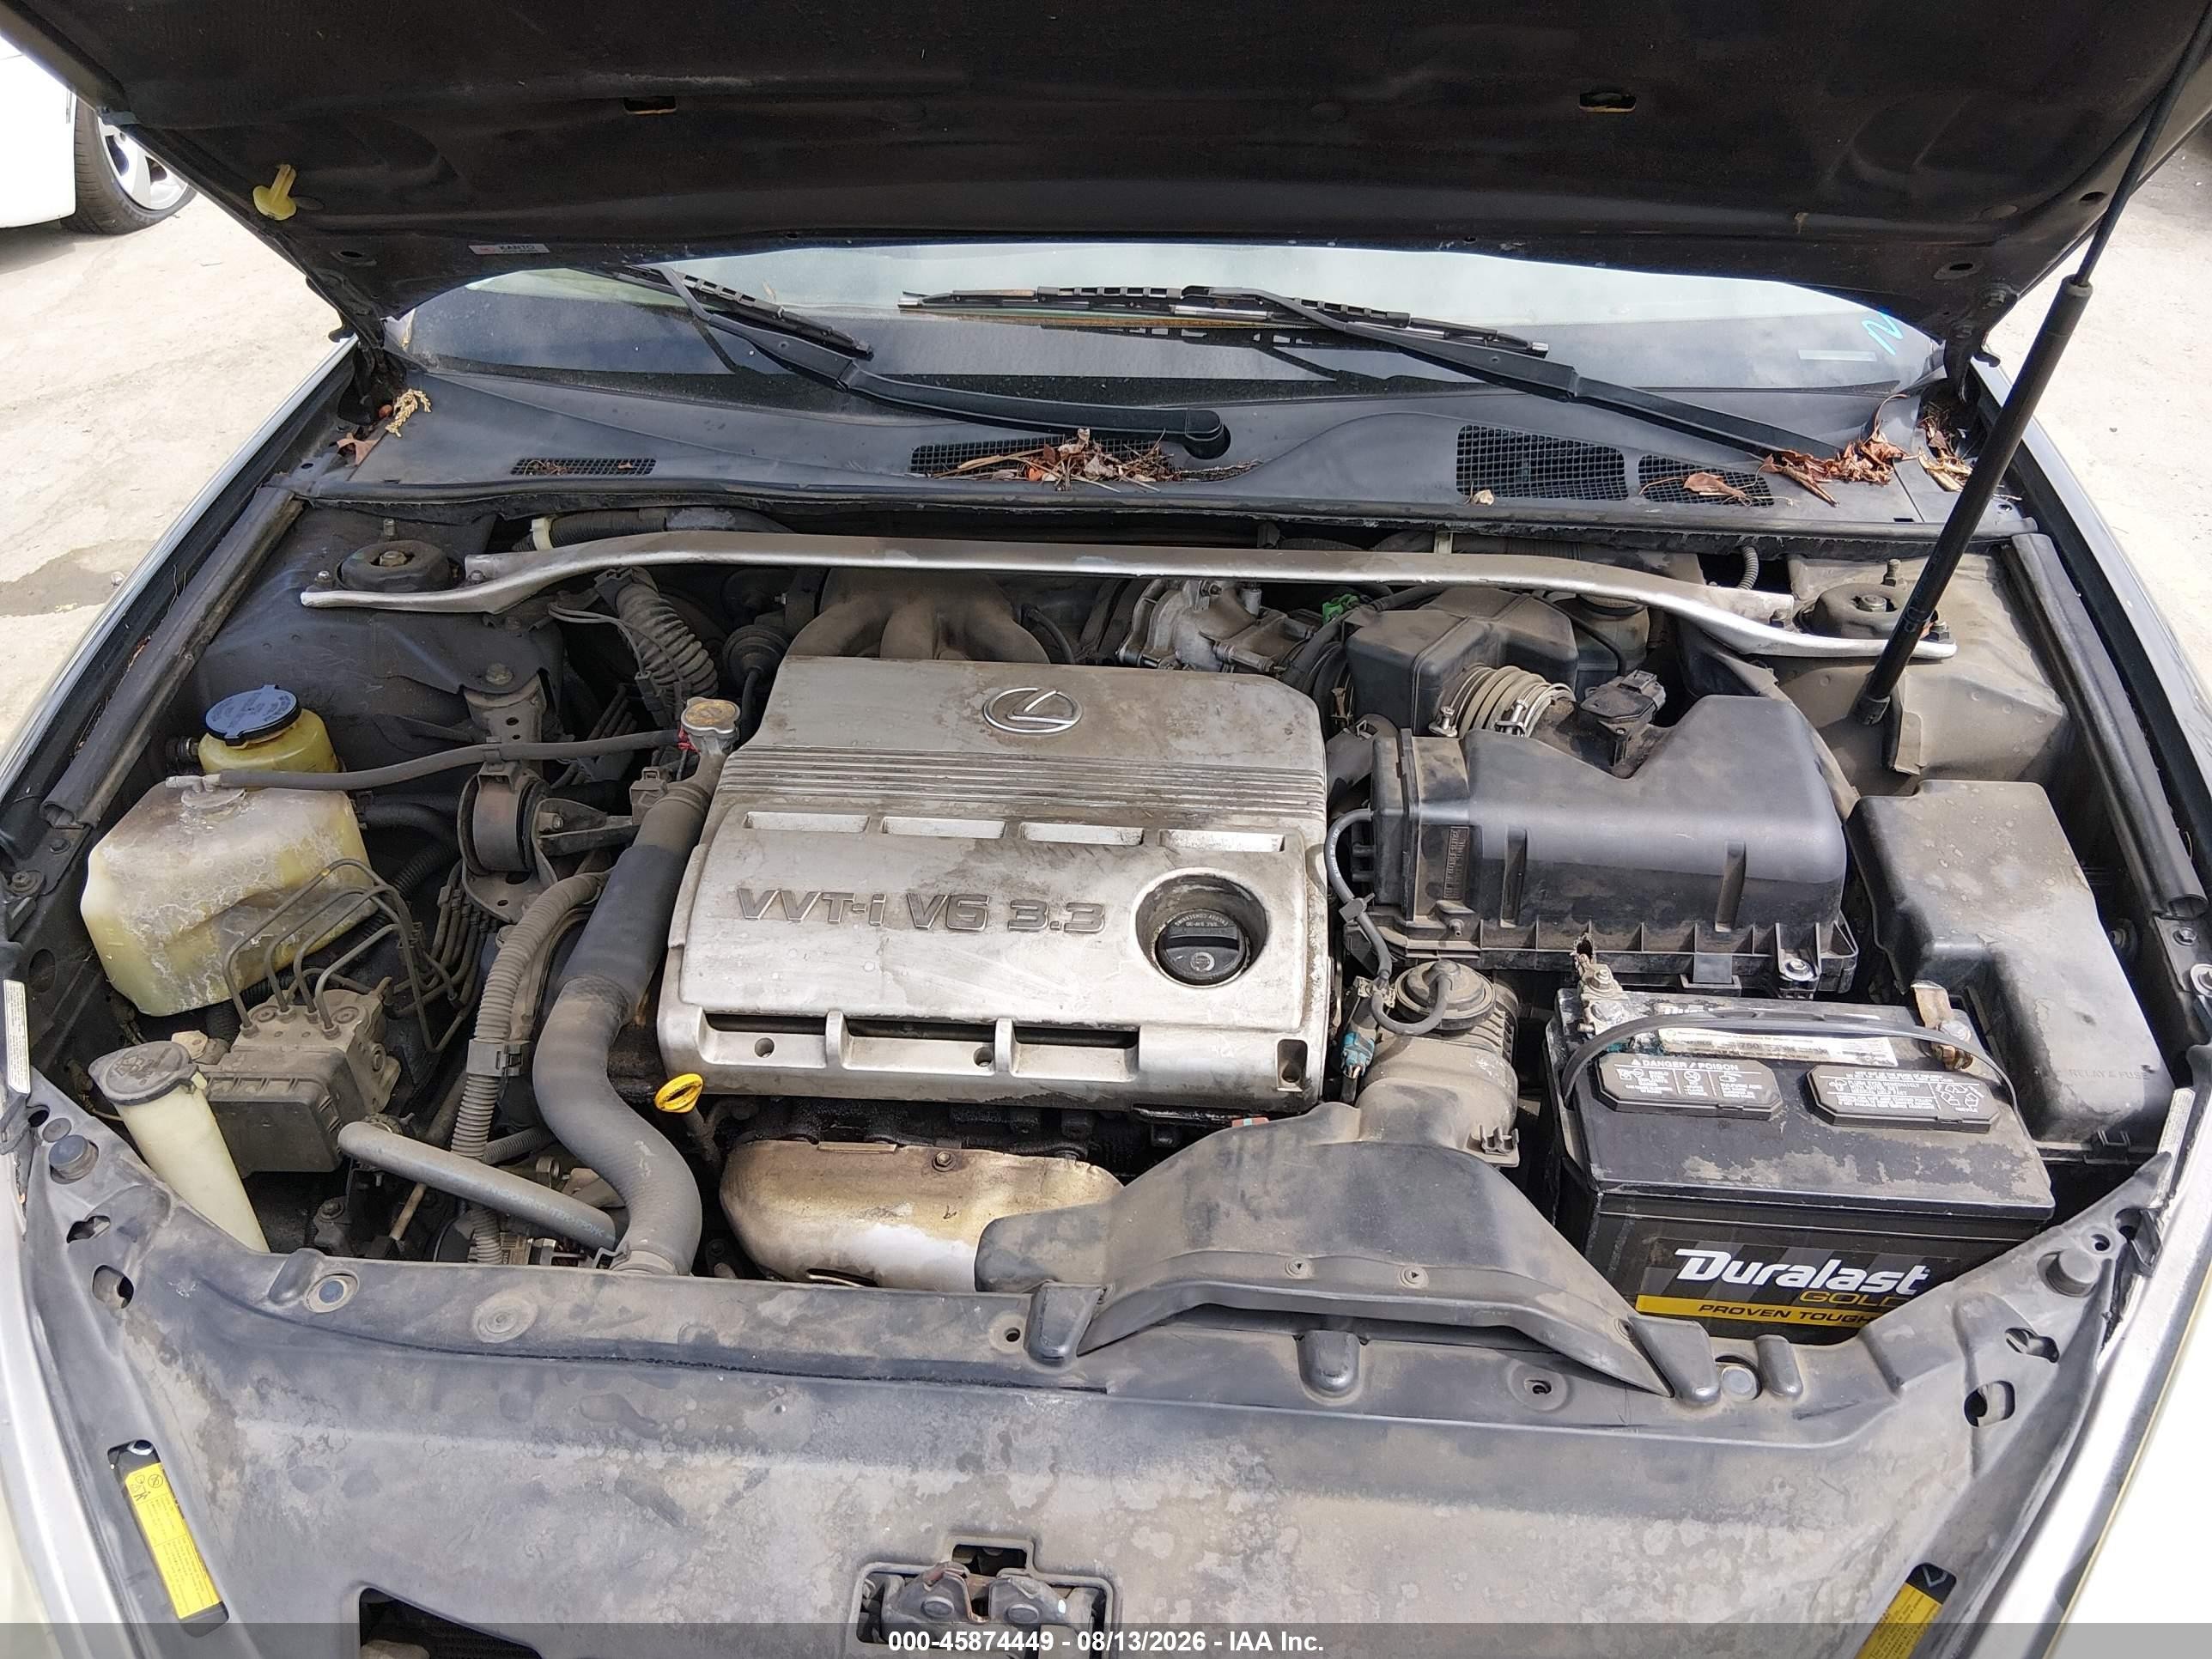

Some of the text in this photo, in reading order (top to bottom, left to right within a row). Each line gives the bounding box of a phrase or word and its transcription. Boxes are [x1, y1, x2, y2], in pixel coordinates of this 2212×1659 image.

[737, 888, 1106, 934] VVT-i V6 3.3
[1642, 1060, 1686, 1069] DANGER
[1698, 1061, 1739, 1071] POISON
[1674, 1249, 1929, 1295] Duralast
[1698, 1304, 1791, 1318] PROVEN
